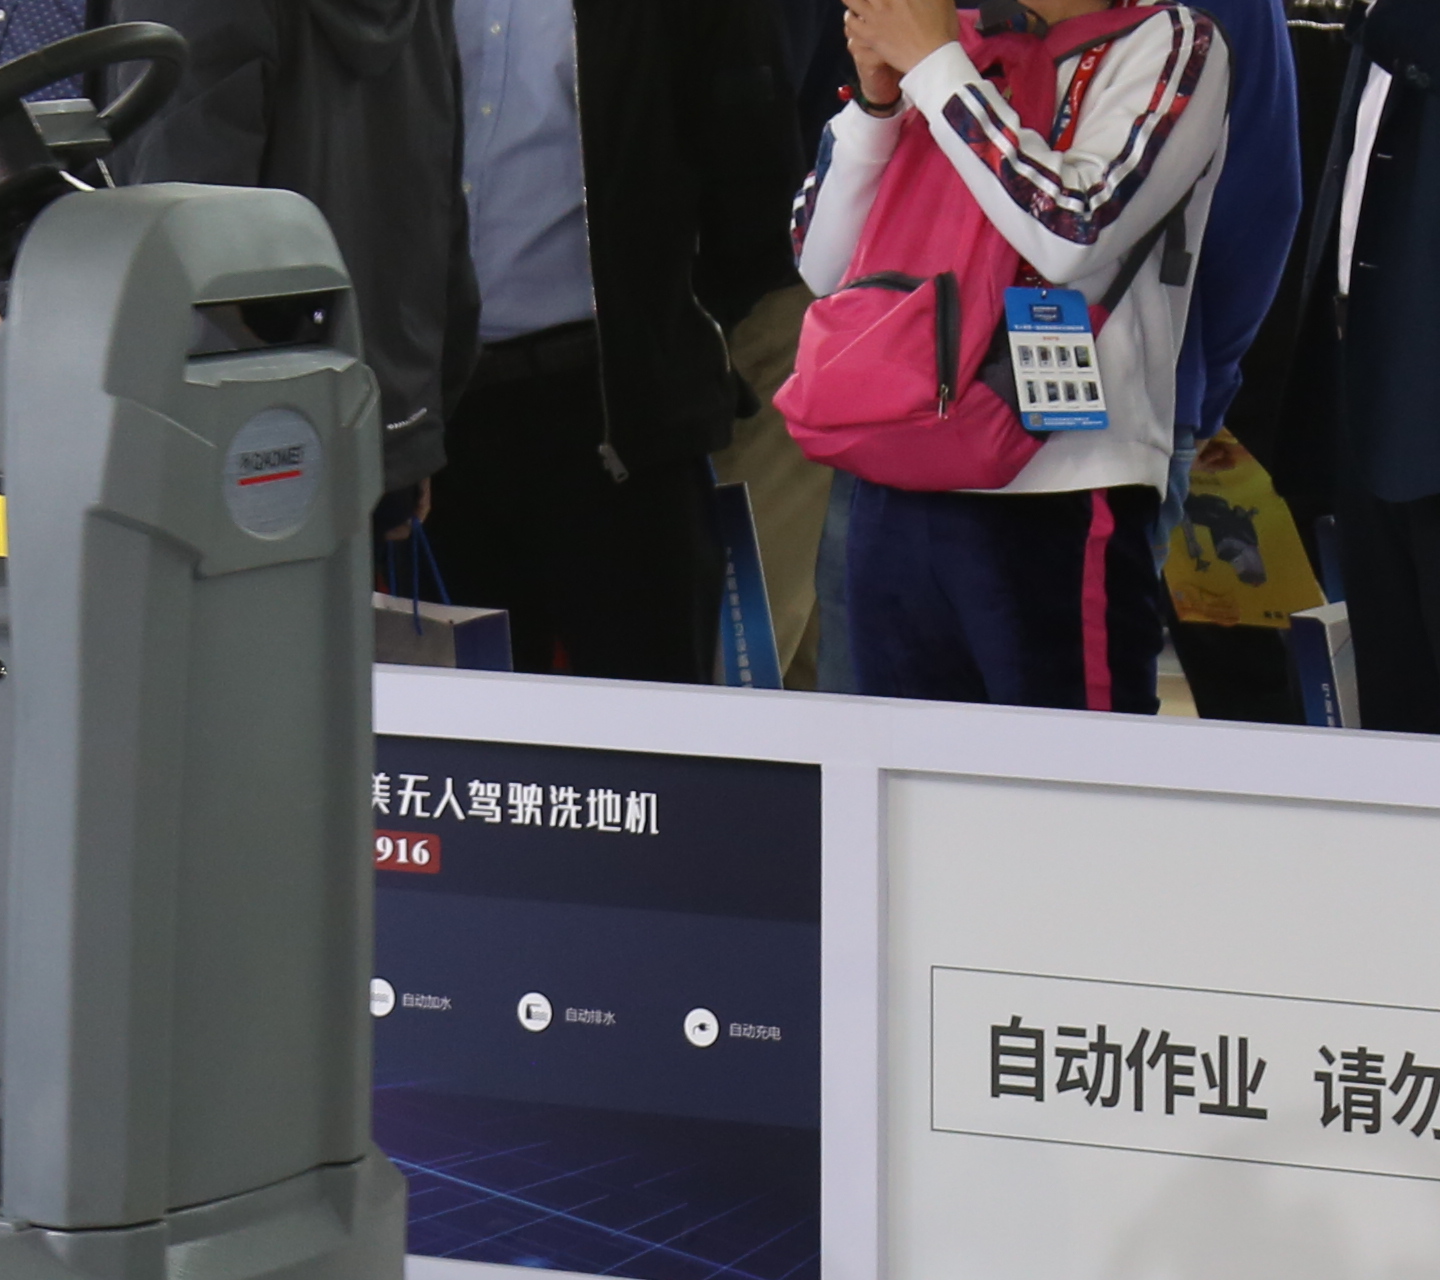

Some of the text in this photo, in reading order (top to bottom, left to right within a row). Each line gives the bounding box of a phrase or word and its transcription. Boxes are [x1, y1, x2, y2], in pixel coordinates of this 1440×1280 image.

[373, 835, 431, 867] 916
[986, 1012, 1269, 1121] 自动作业
